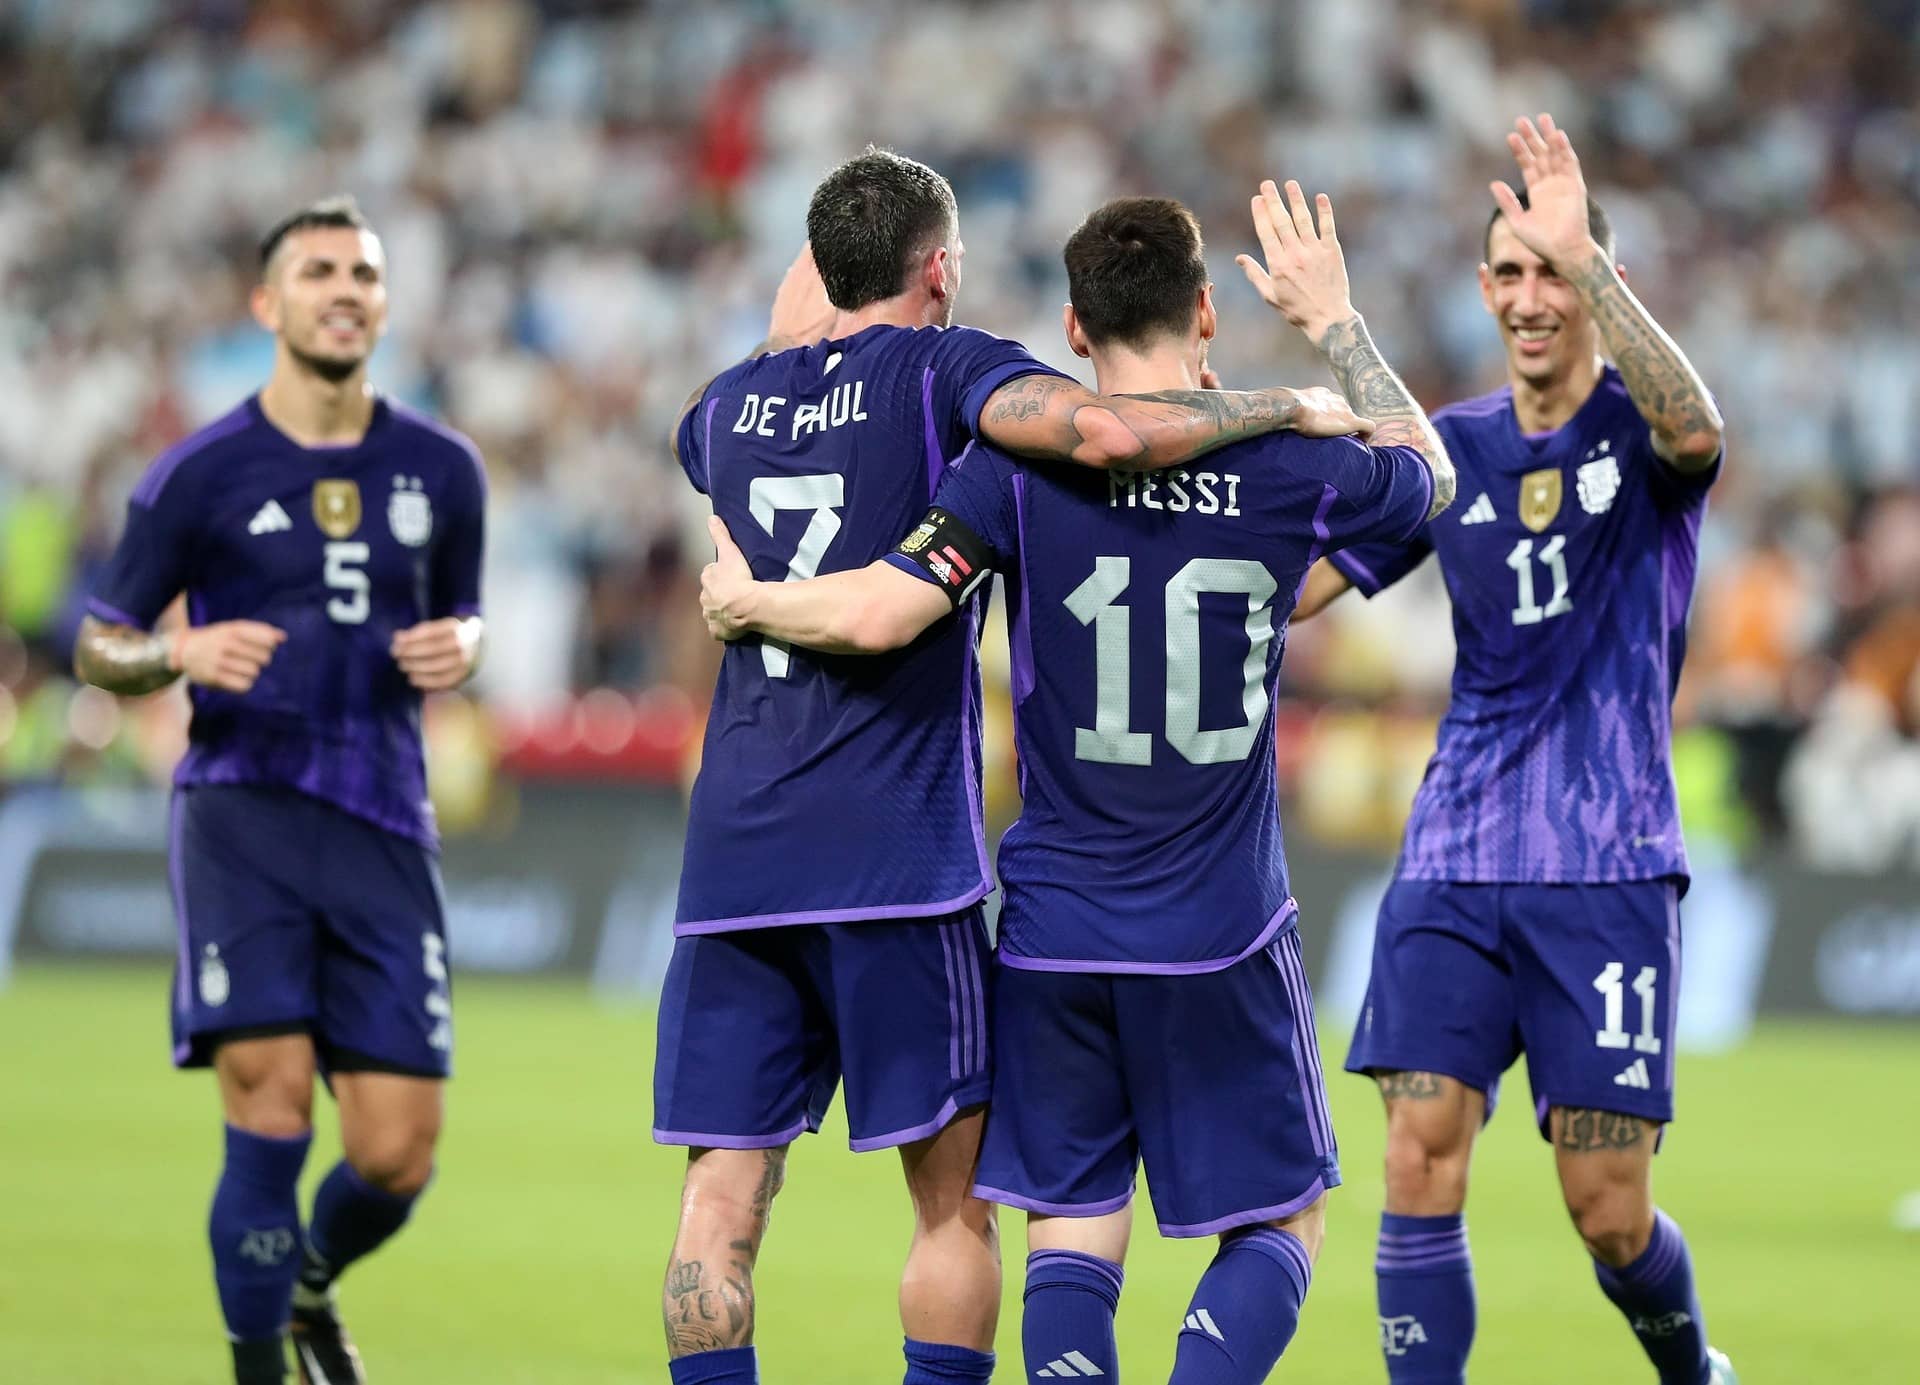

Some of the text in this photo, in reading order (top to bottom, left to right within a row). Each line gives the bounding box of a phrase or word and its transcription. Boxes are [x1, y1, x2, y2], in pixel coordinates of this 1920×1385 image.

[732, 381, 867, 441] DE PAUL
[1109, 468, 1241, 517] MESSI
[323, 541, 371, 625] 5
[748, 473, 845, 678] 7
[1505, 534, 1574, 626] 11
[1062, 556, 1278, 766] 10
[1592, 962, 1661, 1055] 11
